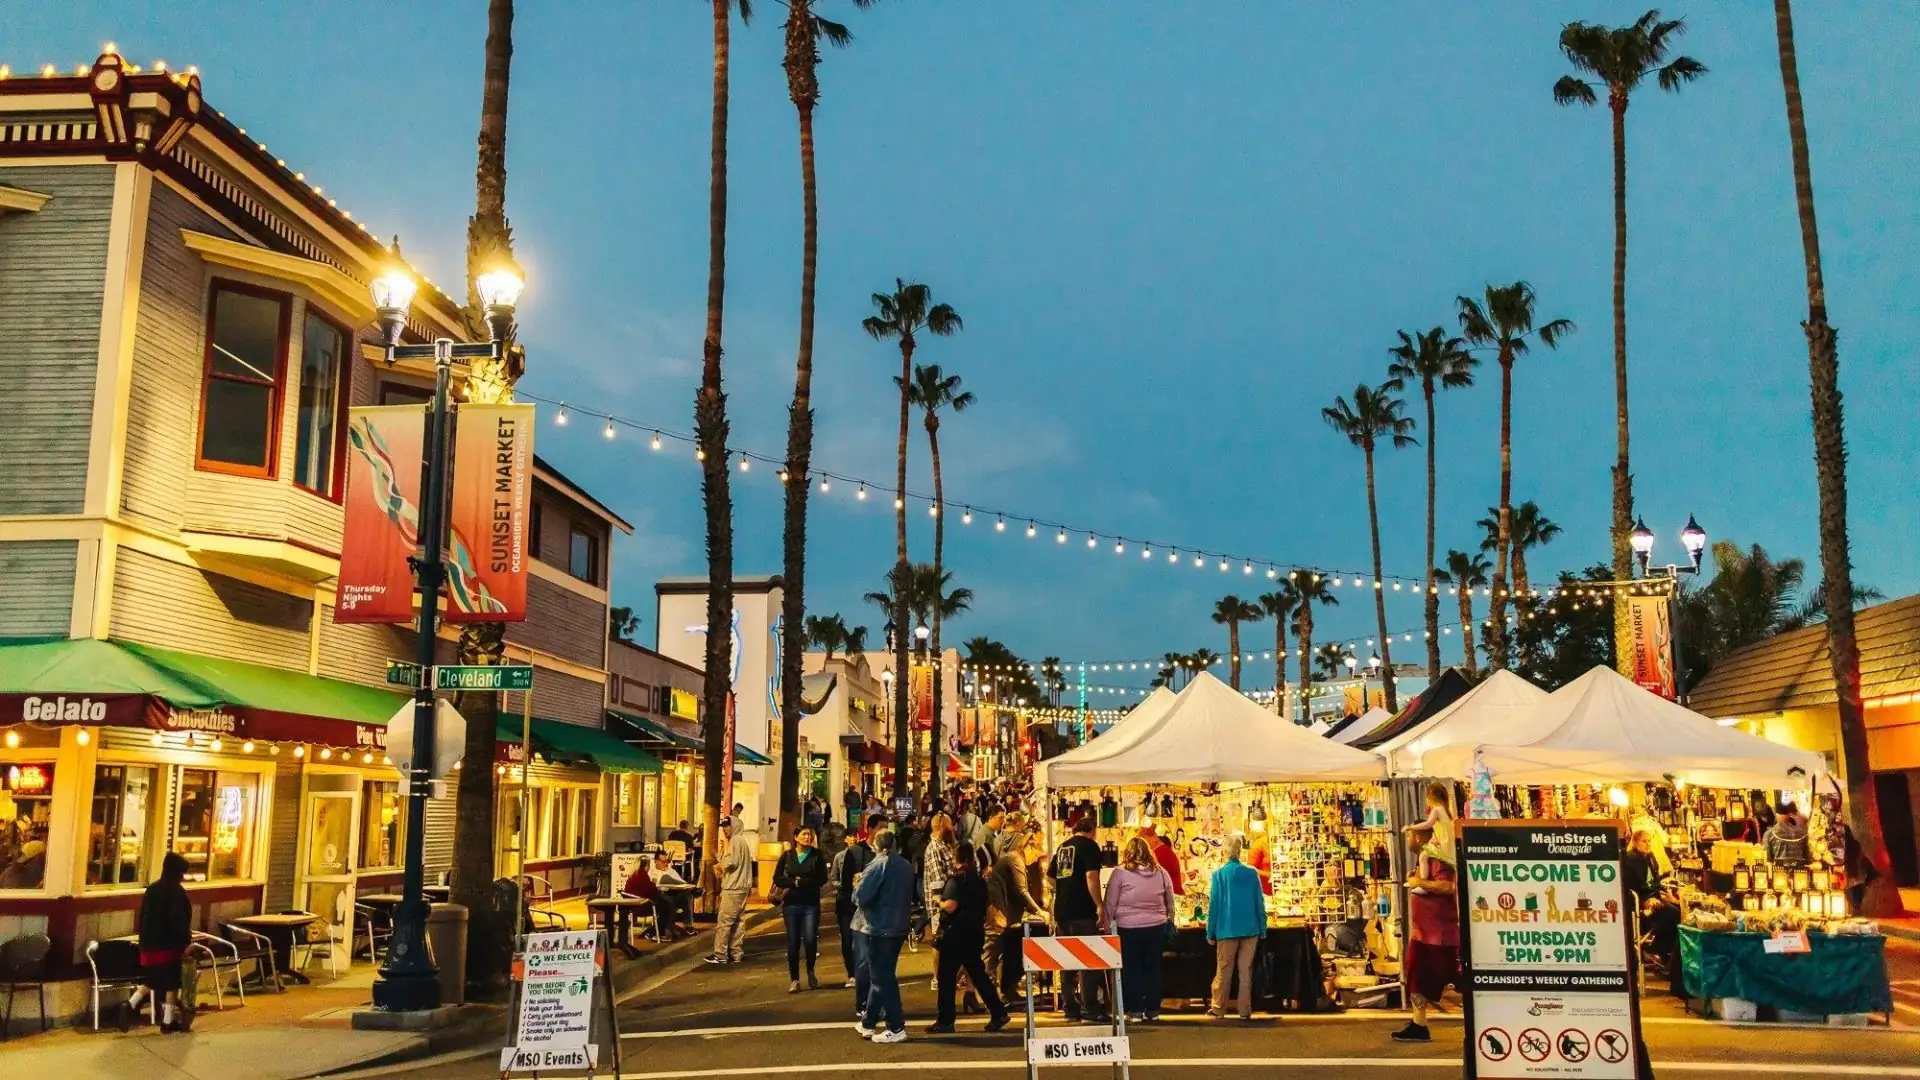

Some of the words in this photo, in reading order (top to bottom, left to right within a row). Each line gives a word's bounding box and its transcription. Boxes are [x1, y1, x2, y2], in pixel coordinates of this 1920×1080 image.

[495, 417, 515, 492] MARKET
[515, 472, 524, 509] WEEKLY
[492, 499, 511, 573] SUNSET
[344, 585, 387, 594] Thursday
[341, 601, 356, 610] 5-9
[343, 593, 373, 603] Nights
[1633, 603, 1643, 639] MARKET
[1636, 642, 1646, 677] SUNSET
[438, 669, 502, 687] Cleveland
[23, 696, 107, 721] Gelato
[168, 707, 235, 731] Smoothies
[1531, 833, 1607, 844] MainStreet
[1547, 843, 1592, 856] Oceanside
[1468, 863, 1581, 882] WELCOME
[1586, 863, 1616, 882] TO
[1471, 909, 1541, 923] SUNSET
[1547, 909, 1619, 923] MARKET
[1497, 930, 1597, 946] THURSDAYS
[557, 952, 591, 960] RECYCLE
[1505, 948, 1542, 962] 5PM
[1553, 948, 1591, 963] 9PM
[545, 981, 566, 989] BEFORE
[1474, 975, 1534, 985] OCEANSIDE'S
[1535, 976, 1569, 985] WEEKLY
[1571, 976, 1624, 986] GATHERING
[1044, 1043, 1069, 1058] MSO
[1074, 1042, 1114, 1056] Events
[516, 1052, 540, 1067] MSO
[545, 1052, 583, 1065] Events
